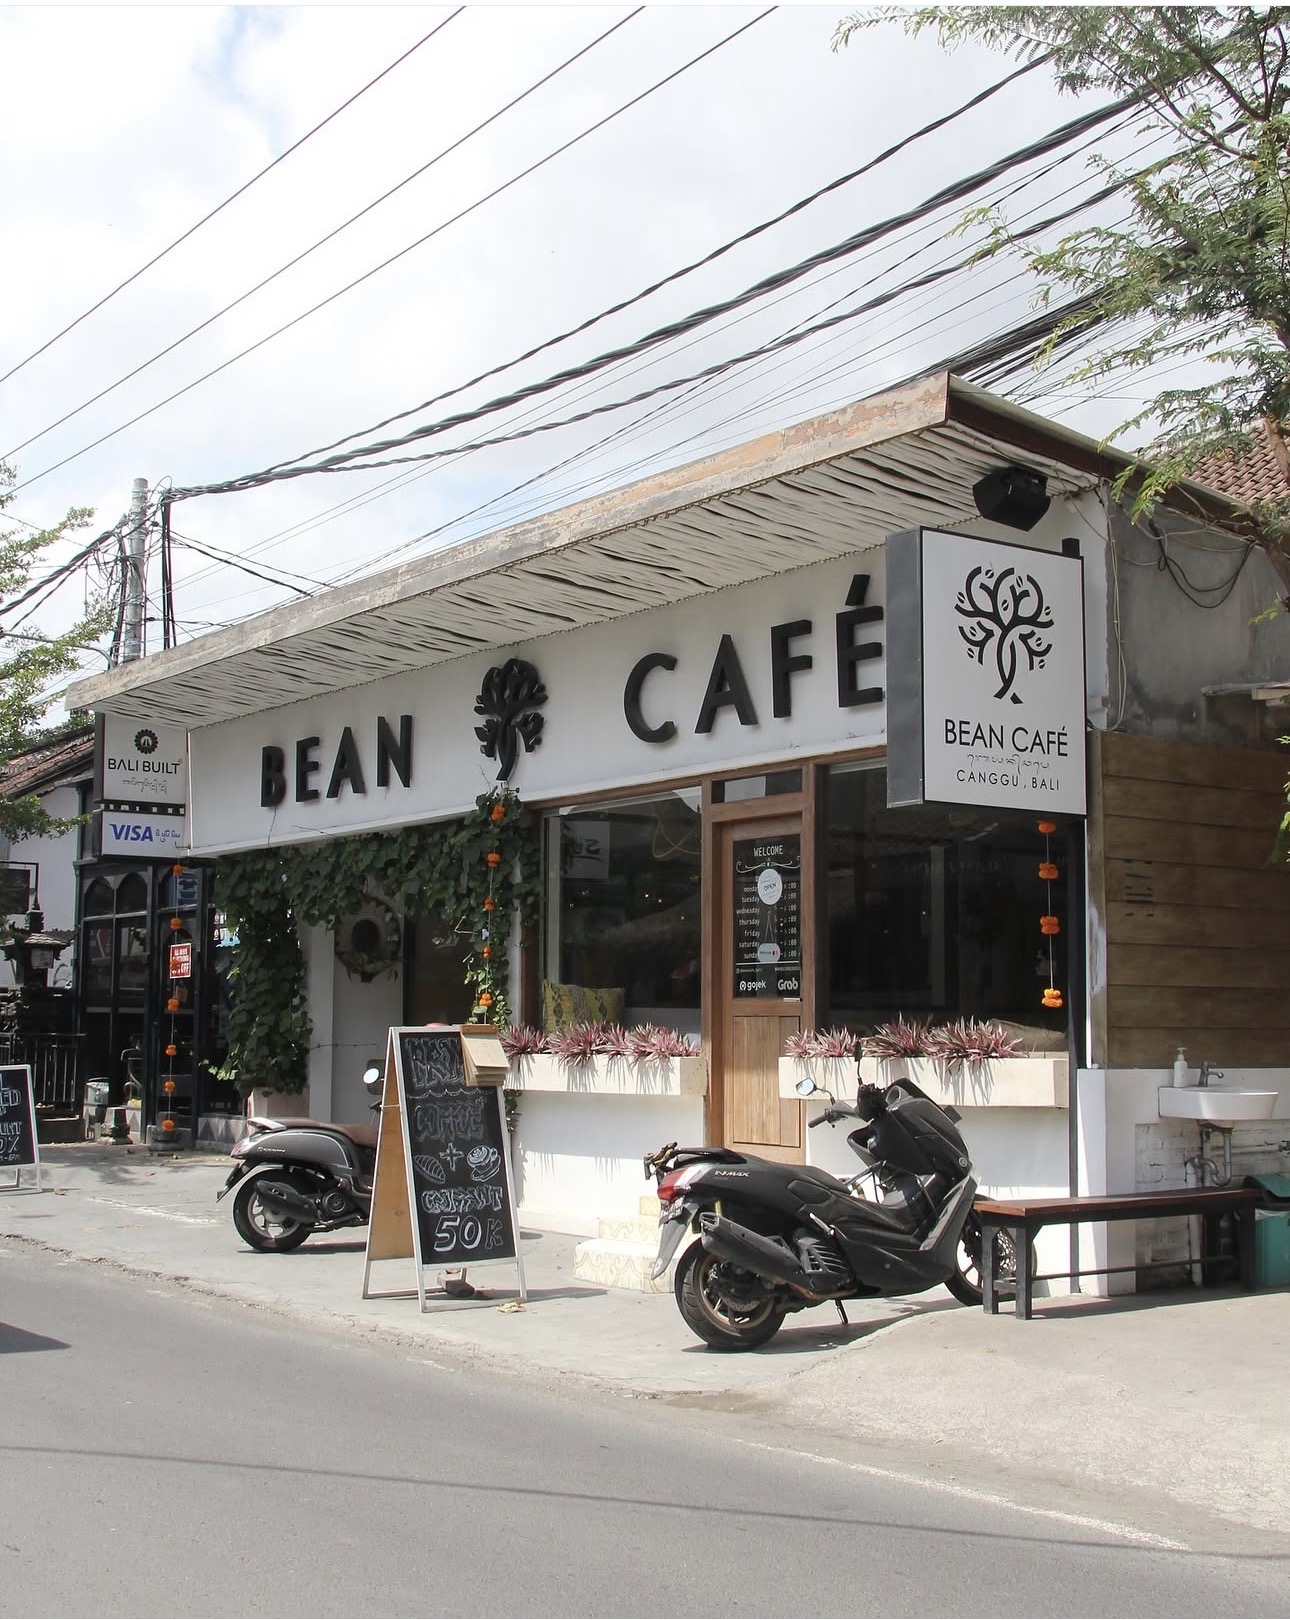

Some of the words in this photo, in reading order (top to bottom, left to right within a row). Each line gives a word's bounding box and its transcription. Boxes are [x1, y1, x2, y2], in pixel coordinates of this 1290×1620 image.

[260, 714, 412, 808] BEAN
[623, 574, 885, 744] CAFÉ
[945, 718, 1004, 749] BEAN
[1012, 726, 1068, 757] CAFÉ
[107, 758, 139, 772] BALI
[142, 760, 181, 775] BUILT
[1031, 776, 1060, 791] BALI
[108, 823, 154, 842] VISA
[753, 845, 784, 857] WELCOME
[743, 885, 759, 893] monda
[763, 882, 777, 892] OPEN
[741, 895, 760, 904] tuesday
[736, 907, 760, 915] wednesday
[739, 918, 760, 927] thursday
[744, 930, 760, 938] friday
[738, 941, 760, 949] saturday
[747, 980, 767, 991] gojek
[777, 977, 799, 991] Grab
